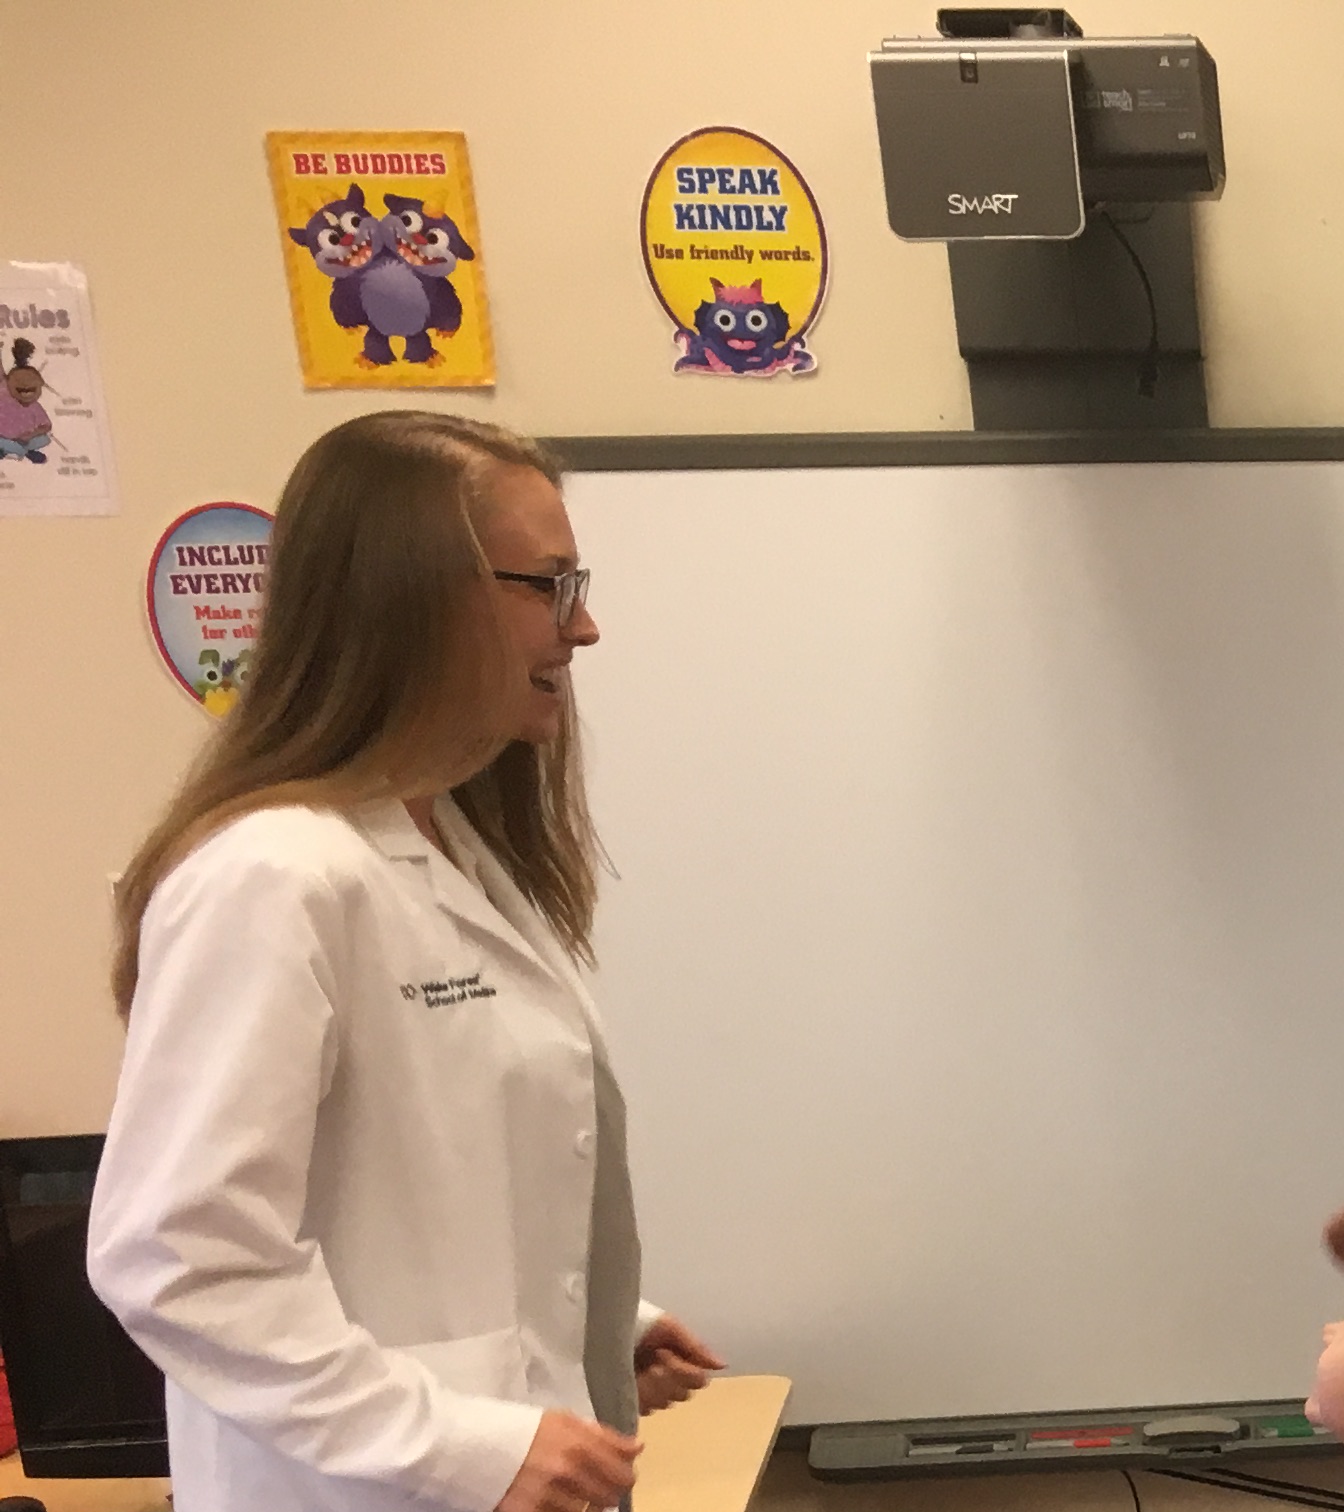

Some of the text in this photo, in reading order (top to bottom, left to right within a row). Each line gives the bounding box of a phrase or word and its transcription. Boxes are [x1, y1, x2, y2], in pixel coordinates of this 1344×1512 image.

[292, 153, 446, 175] BE BUDDIES
[676, 167, 780, 195] SPEAK
[948, 194, 1018, 214] SMART
[673, 203, 788, 231] KINDLY
[652, 243, 815, 264] Use friendly words.
[176, 544, 274, 566] INCLUD
[169, 573, 267, 595] EVERYO
[193, 604, 242, 620] Make
[202, 624, 227, 639] for
